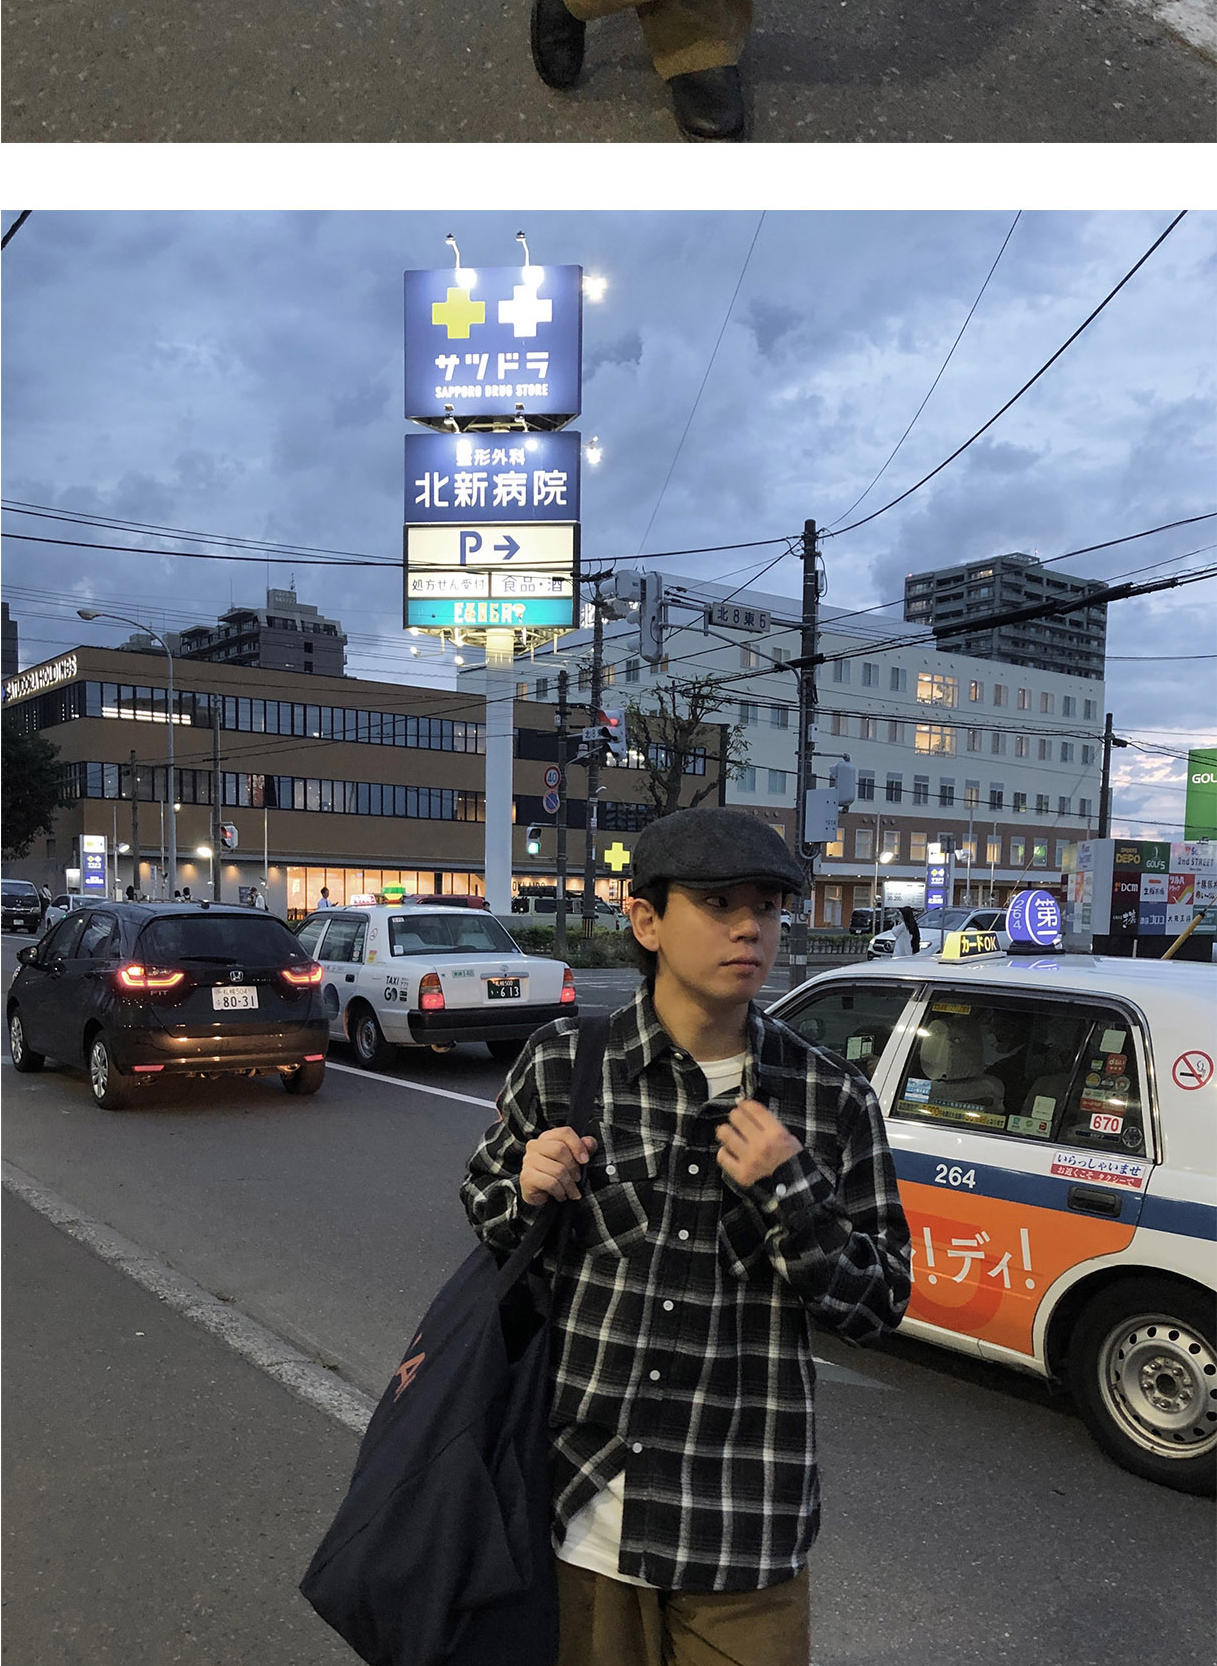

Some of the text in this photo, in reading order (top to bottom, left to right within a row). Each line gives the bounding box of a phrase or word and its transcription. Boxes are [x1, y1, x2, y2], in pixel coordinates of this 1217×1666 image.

[435, 351, 549, 381] サツドラ
[435, 383, 548, 399] SAPPORO DRUG STORE
[414, 469, 568, 507] 北新病院
[460, 530, 483, 566] P
[1115, 853, 1140, 864] DEPO
[223, 996, 255, 1008] 80-31
[1092, 1115, 1120, 1132] 670
[935, 1164, 976, 1188] 264
[1057, 1153, 1142, 1177] いらっしゃいませ
